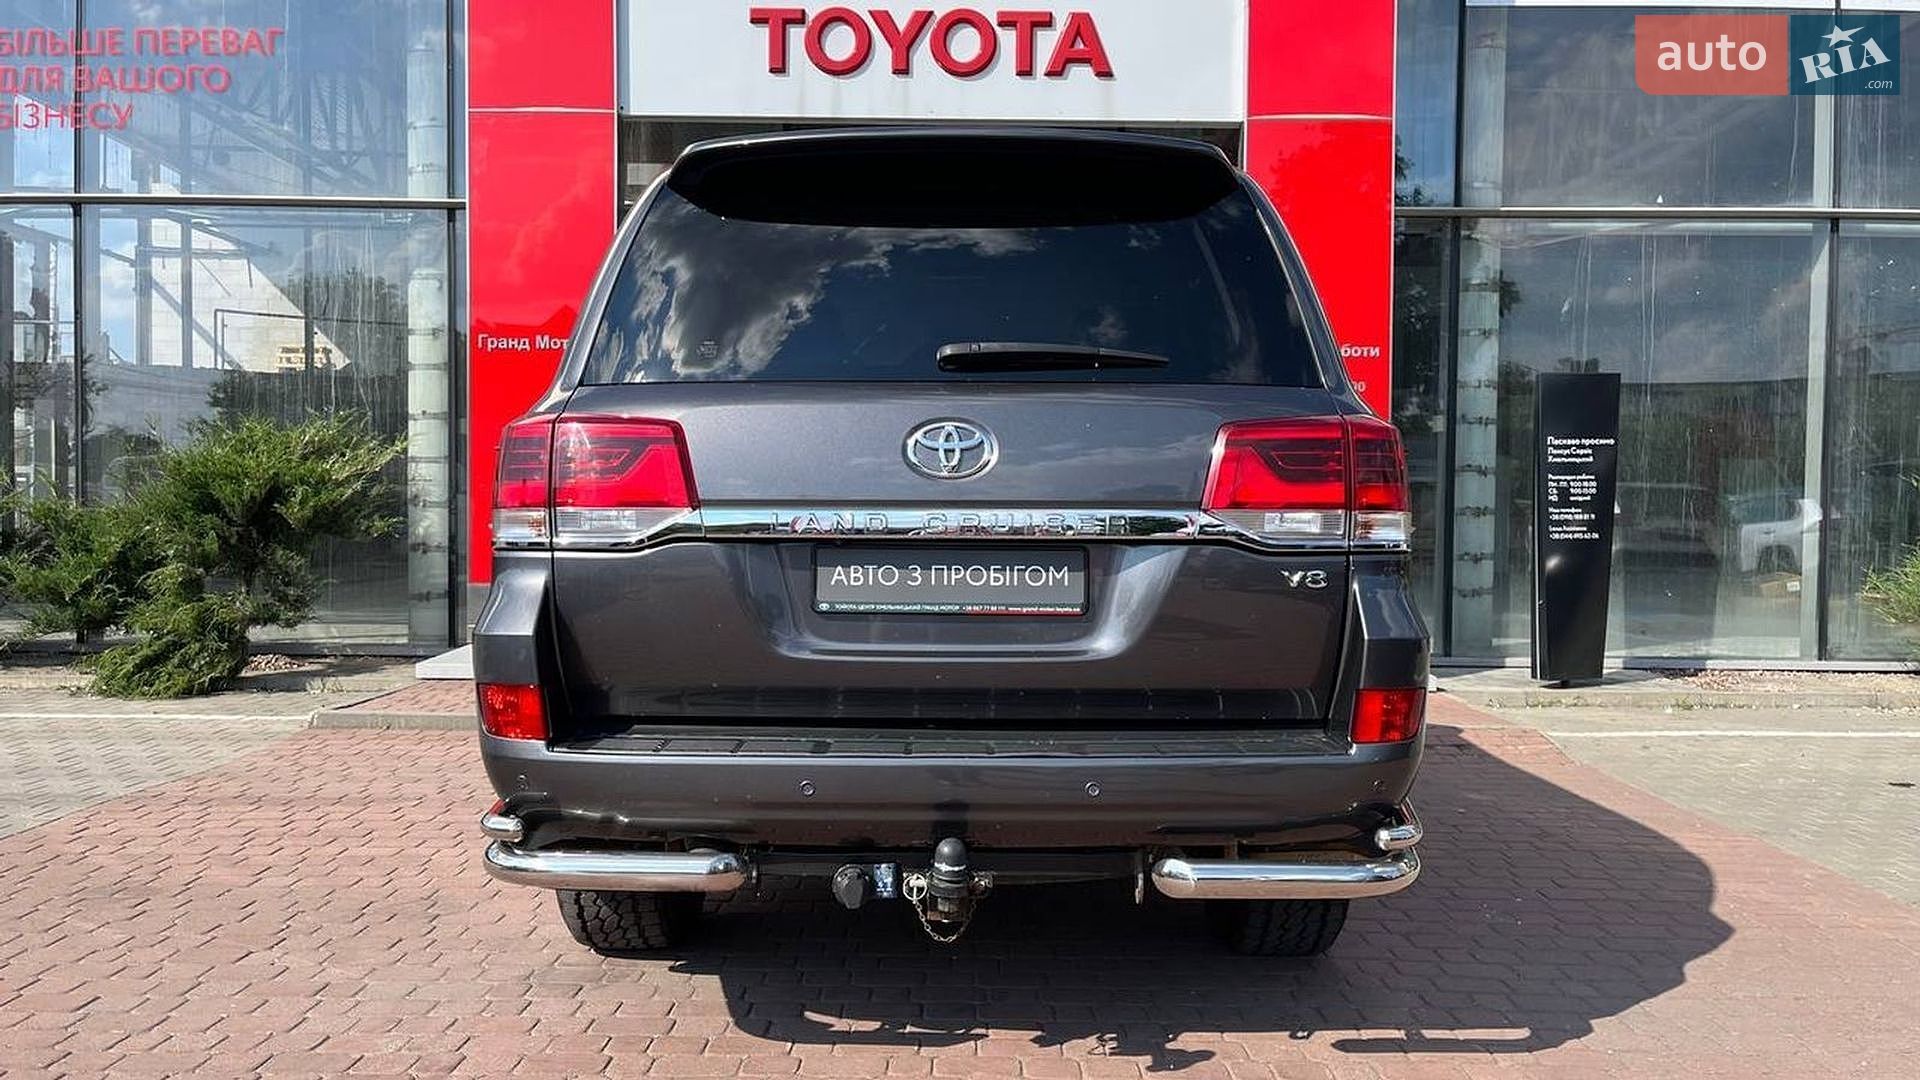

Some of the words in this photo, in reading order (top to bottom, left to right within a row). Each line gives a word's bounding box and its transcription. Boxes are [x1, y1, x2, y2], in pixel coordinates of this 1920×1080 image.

[133, 28, 284, 57] ПЕРЕВАГ
[750, 7, 1114, 77] TOYOTA
[74, 64, 232, 94] ВАШОГО
[477, 333, 530, 352] Гранд
[769, 512, 889, 534] LAND
[921, 512, 1130, 535] CRUISER
[831, 565, 899, 587] АВТО
[906, 566, 922, 587] З
[931, 565, 1069, 587] ПРОБІГОМ
[1281, 570, 1329, 588] V8
